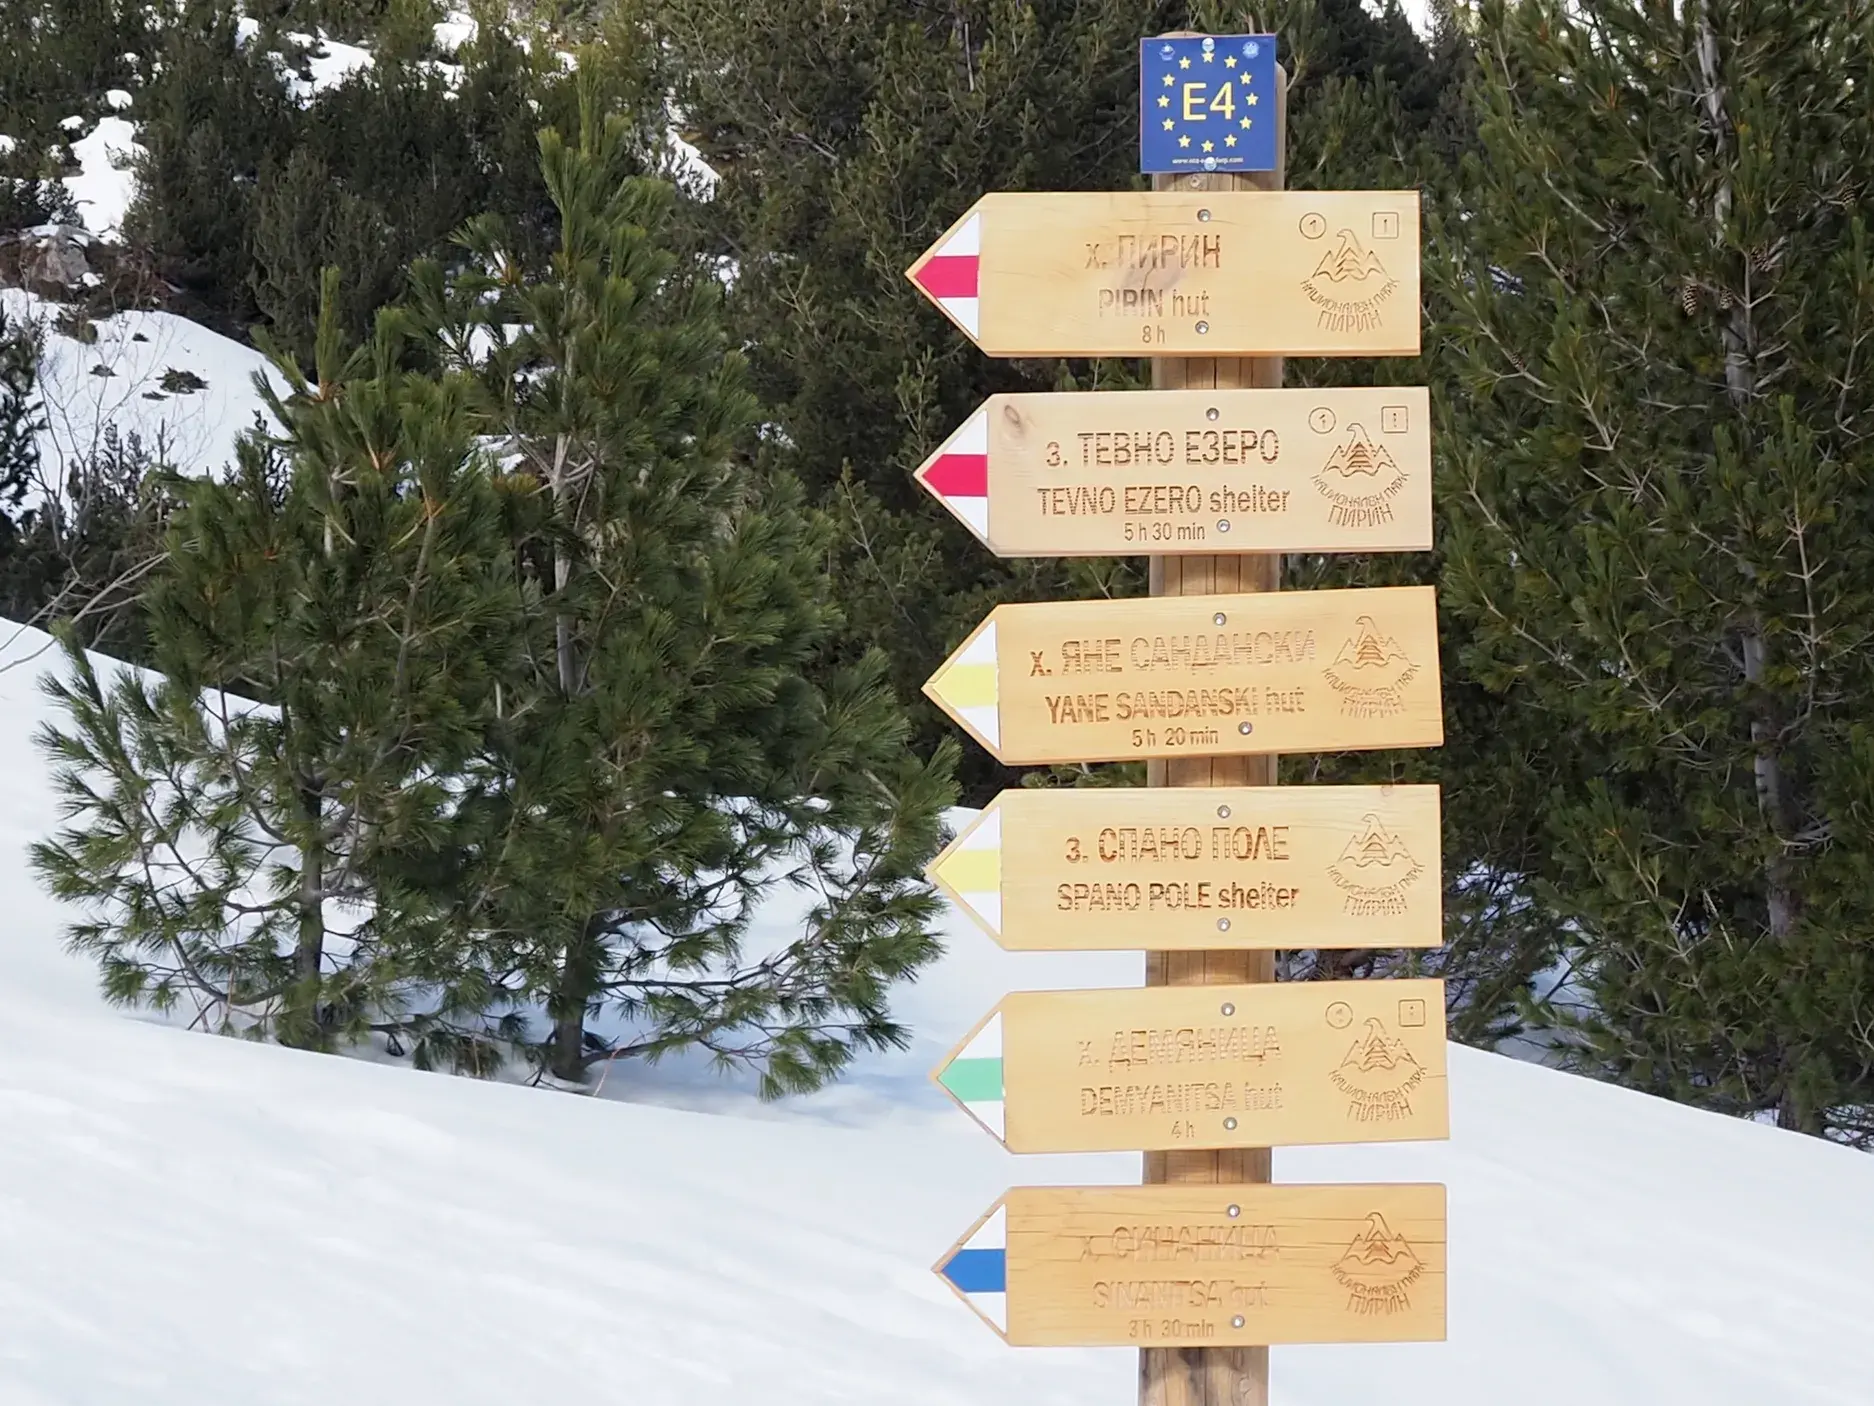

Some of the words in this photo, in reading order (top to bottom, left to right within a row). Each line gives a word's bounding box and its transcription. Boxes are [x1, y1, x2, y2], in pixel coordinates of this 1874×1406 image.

[1183, 81, 1236, 121] E4
[1117, 234, 1221, 269] ПИРИН
[1099, 288, 1163, 317] PIRIN
[1172, 289, 1210, 317] hut
[1142, 325, 1152, 344] 8
[1156, 325, 1166, 344] h
[1317, 309, 1383, 333] ПИРИН
[1077, 431, 1175, 466] ТЕВНО
[1186, 429, 1280, 465] ЕЗЕРО
[1037, 487, 1116, 515] TEVNO
[1124, 485, 1203, 515] EZERO
[1209, 484, 1290, 513] shelter
[1328, 503, 1394, 527] ПИРИН
[1124, 522, 1134, 541] 5
[1139, 522, 1148, 541] h
[1152, 522, 1172, 541] 30
[1177, 522, 1206, 541] min
[1061, 639, 1123, 675] ЯНЕ
[1130, 630, 1316, 675] САНДАНСКИ
[1045, 694, 1110, 724] YANE
[1116, 687, 1258, 720] SANDANSKI
[1266, 686, 1305, 715] hut
[1132, 730, 1143, 747] 5
[1147, 729, 1156, 746] h
[1165, 727, 1186, 746] 20
[1189, 726, 1219, 745] min
[1099, 827, 1201, 863] СПАНО
[1212, 826, 1290, 860] ПОЛЕ
[1057, 882, 1141, 911] SPANO
[1149, 882, 1211, 910] POLE
[1218, 882, 1300, 909] shelter
[1109, 1026, 1282, 1073] ДЕМЯНИЦА
[1081, 1082, 1237, 1115] DEMYANITSA
[1245, 1082, 1283, 1111] hut
[1347, 1098, 1413, 1122] ПИРИН
[1171, 1121, 1182, 1138] 4
[1186, 1121, 1195, 1138] h
[1346, 1292, 1412, 1316] ПИРИН
[1129, 1319, 1139, 1338] 3
[1143, 1319, 1152, 1338] h
[1161, 1319, 1181, 1338] 30
[1186, 1318, 1215, 1338] min
